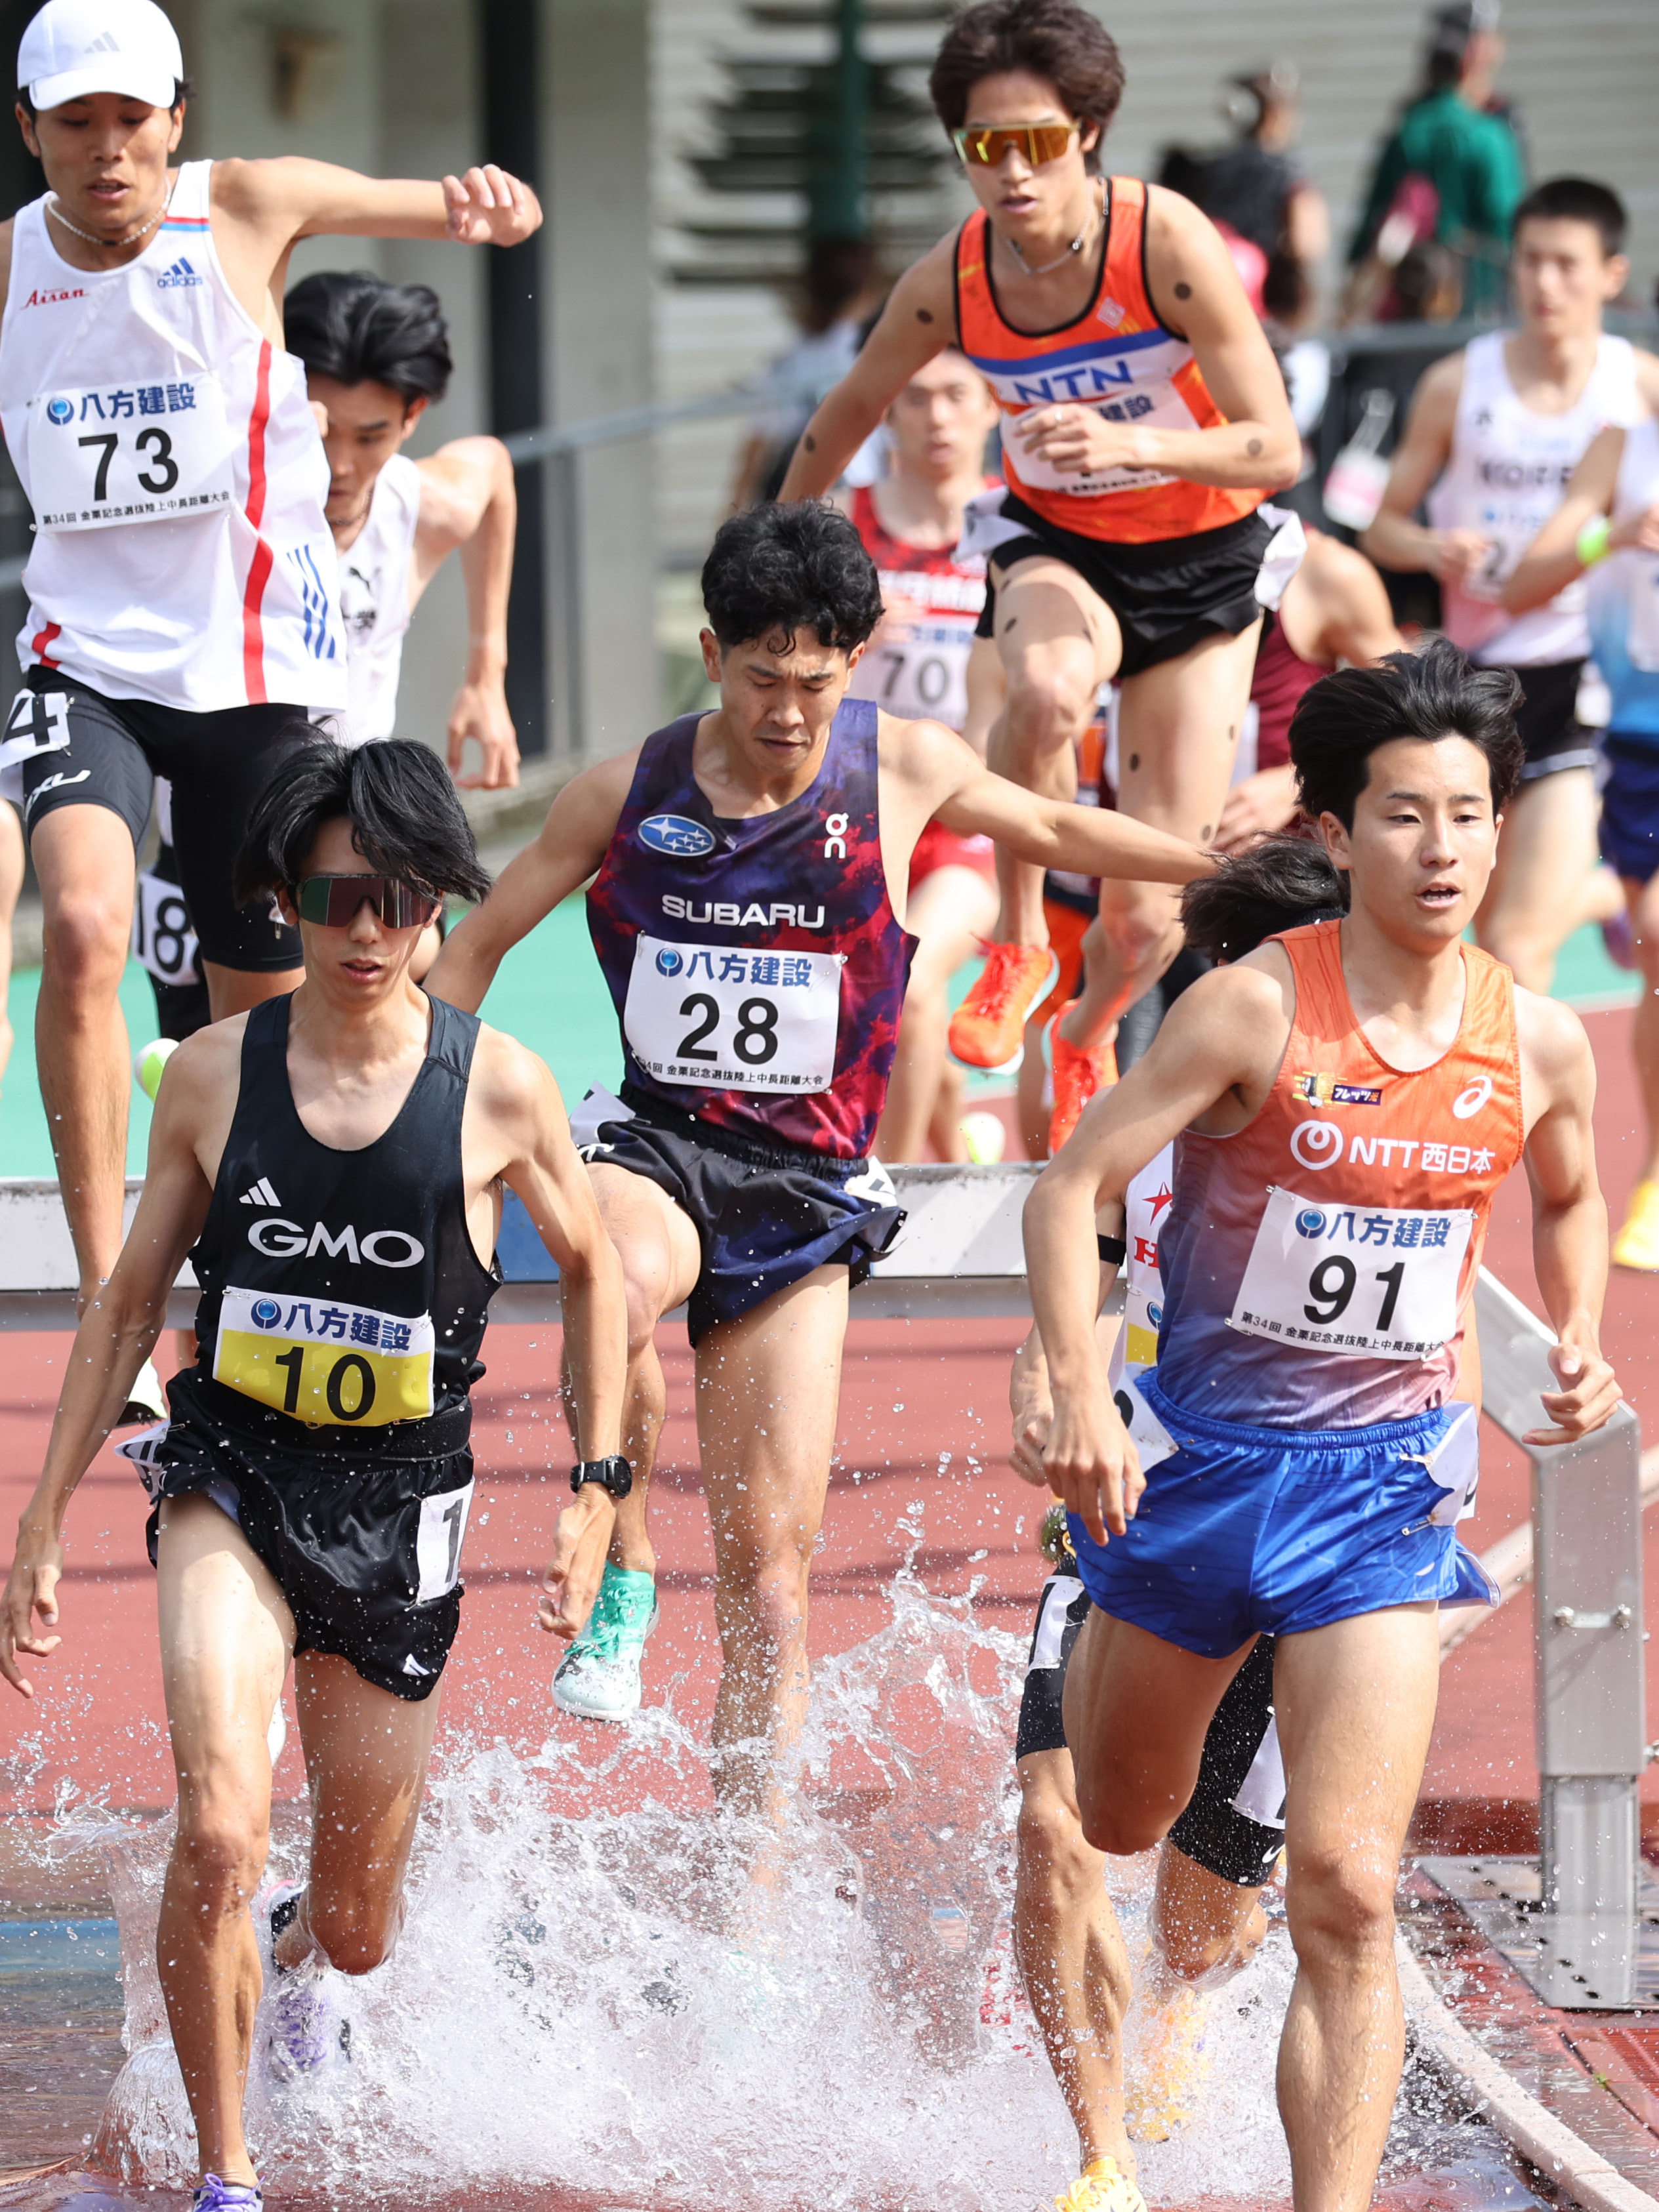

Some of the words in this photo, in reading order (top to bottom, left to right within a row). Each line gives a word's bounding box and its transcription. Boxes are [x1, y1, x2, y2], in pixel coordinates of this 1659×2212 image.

[157, 275, 203, 289] adidas
[79, 382, 197, 422] 八方建設
[1014, 361, 1134, 403] NTN
[77, 427, 178, 501] 73
[882, 651, 949, 705] 70
[662, 894, 825, 928] SUBARU
[686, 952, 812, 988] 八方建設
[676, 993, 779, 1065] 28
[1349, 1136, 1420, 1169] NTT
[1421, 1141, 1496, 1175] 西日本
[248, 1218, 425, 1268] GMO
[1327, 1212, 1451, 1248] 八方建設
[1304, 1255, 1405, 1332] 91
[283, 1303, 411, 1351] 八方建設
[1241, 1311, 1282, 1334] 第34回
[276, 1346, 376, 1422] 10
